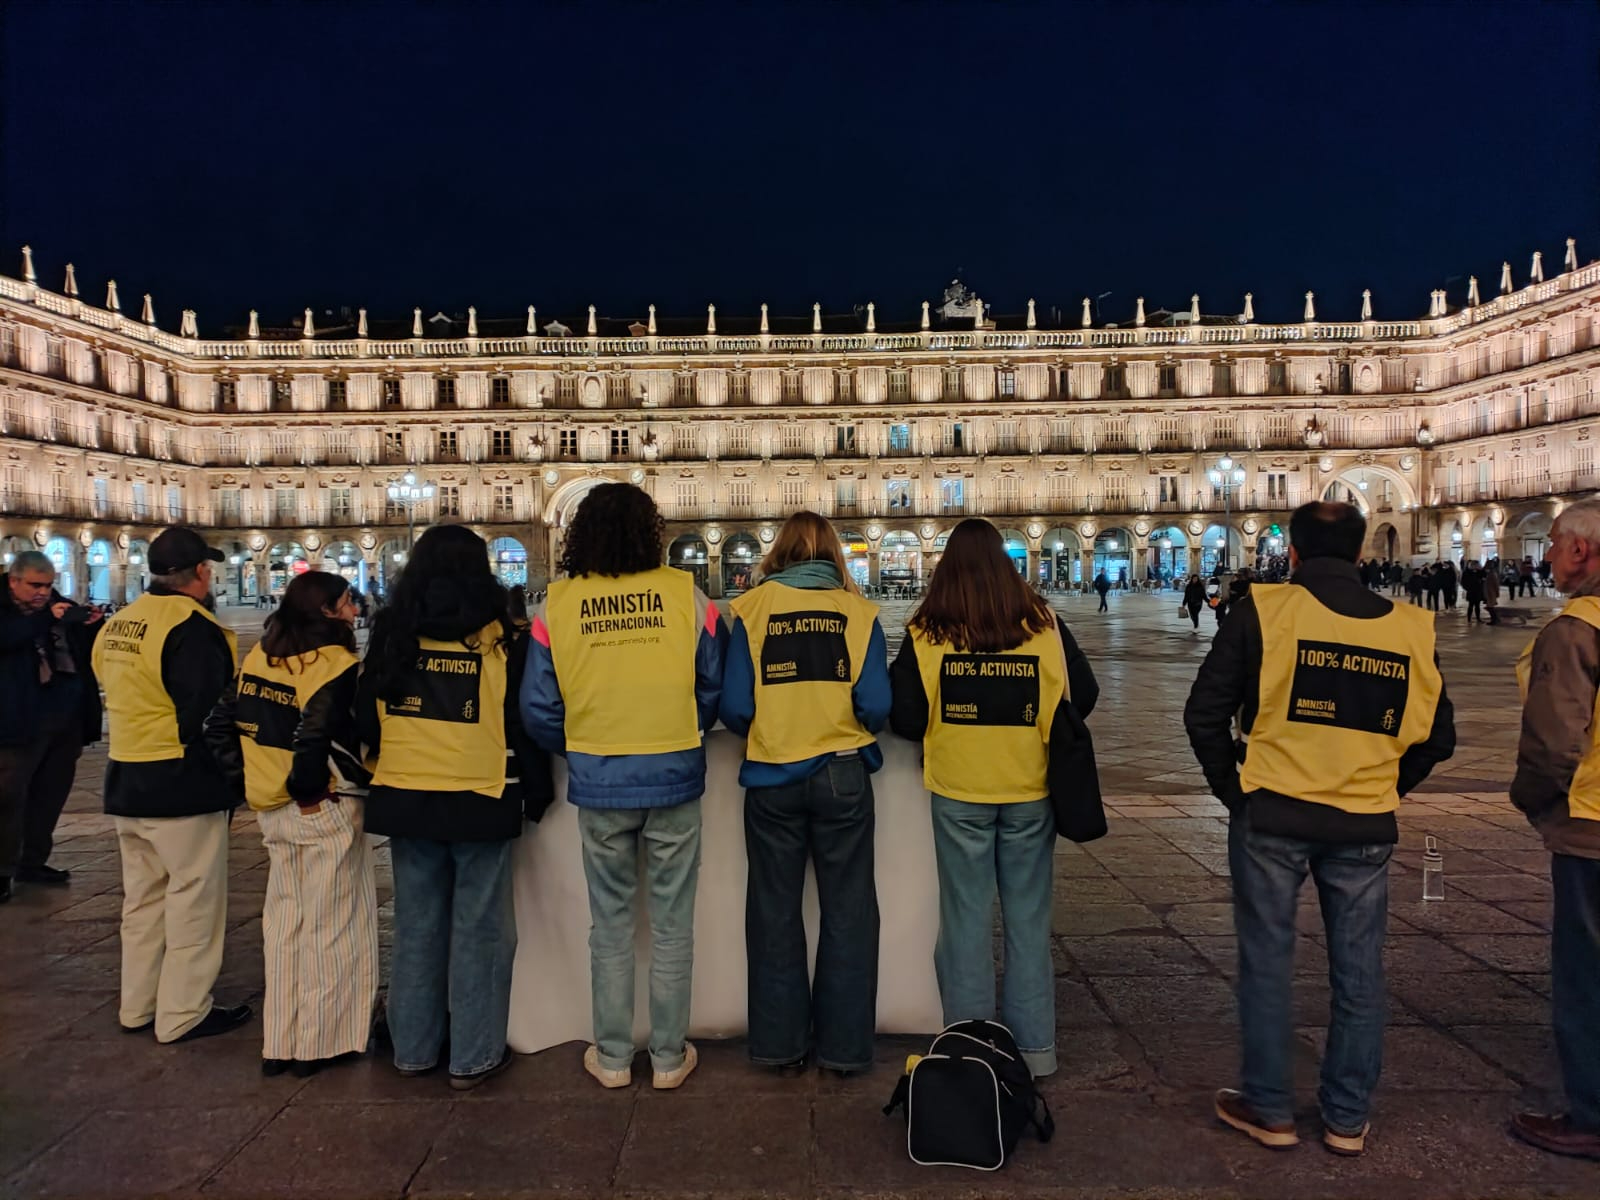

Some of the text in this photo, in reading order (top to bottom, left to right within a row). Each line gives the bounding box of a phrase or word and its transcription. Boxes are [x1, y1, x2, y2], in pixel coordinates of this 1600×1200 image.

[580, 588, 664, 619] AMNISTÍA
[580, 616, 667, 635] INTERNACIONAL
[767, 620, 794, 636] 00%
[425, 657, 478, 675] ACTIVISTA
[766, 660, 797, 673] AMNISTÍA
[944, 661, 1035, 678] 100% ACTIVISTA
[1299, 649, 1406, 681] 100% ACTIVISTA
[945, 702, 978, 713] AMNISTÍA
[1296, 698, 1337, 712] AMNISTÍA
